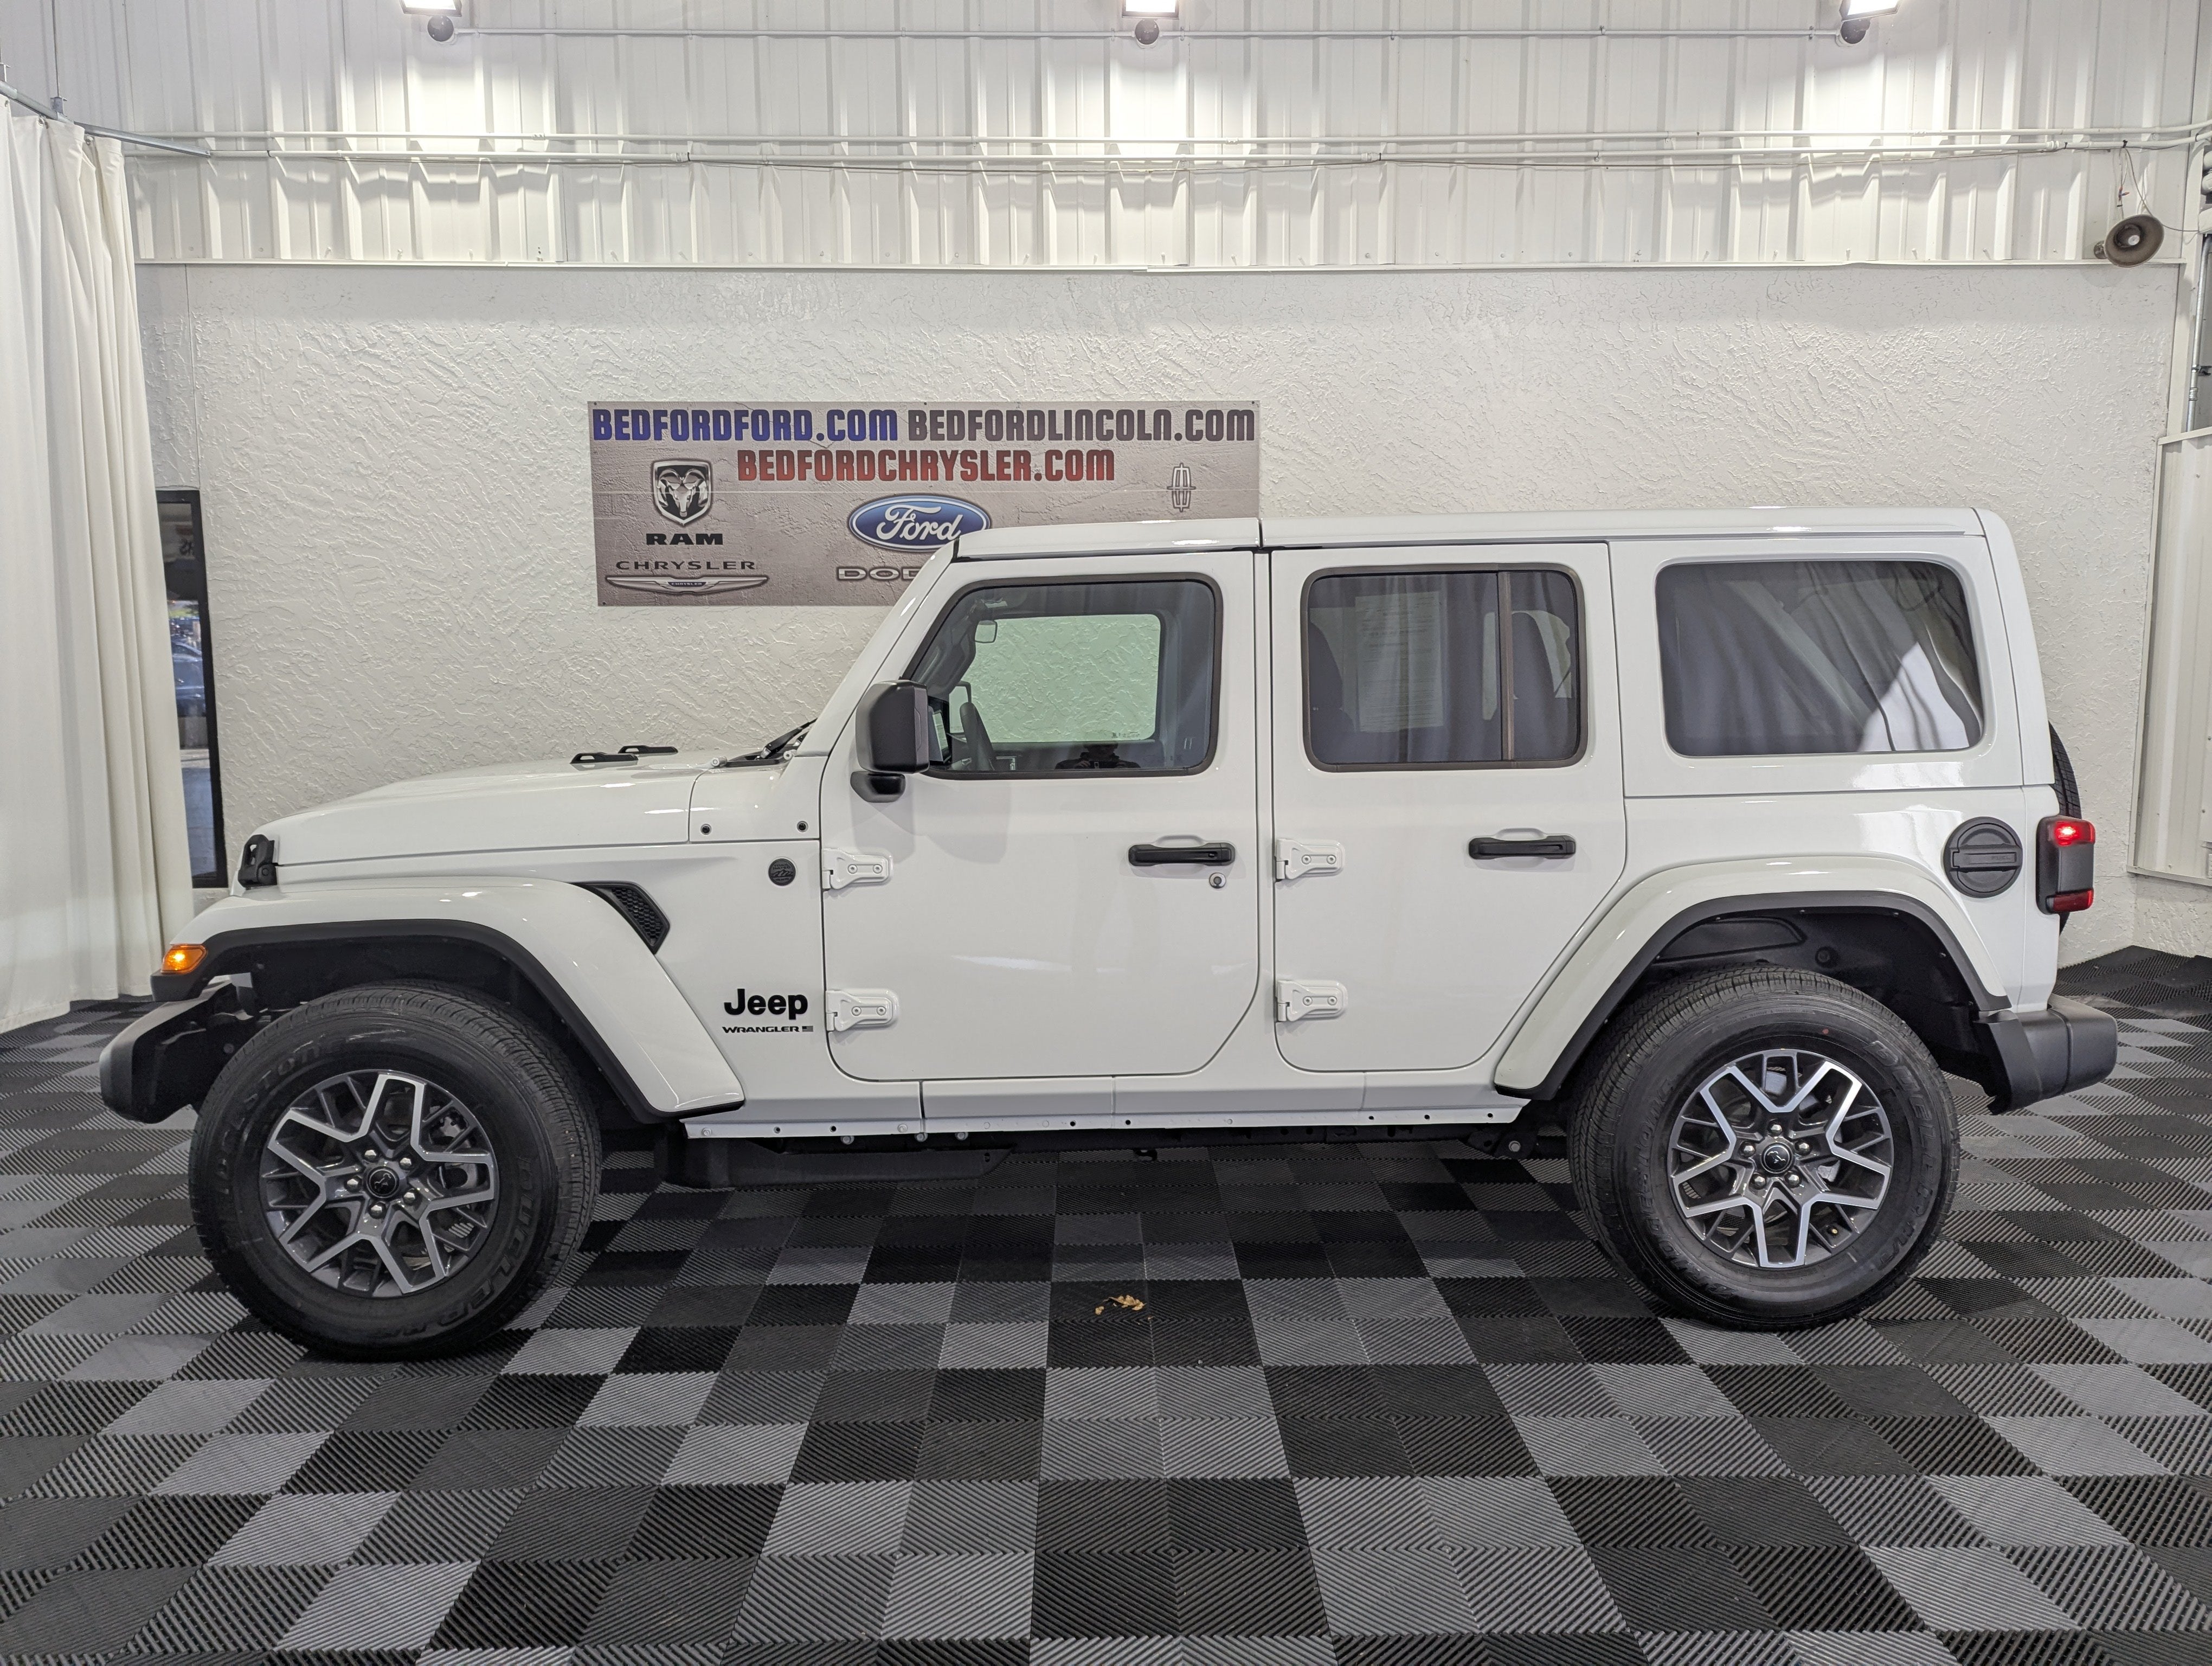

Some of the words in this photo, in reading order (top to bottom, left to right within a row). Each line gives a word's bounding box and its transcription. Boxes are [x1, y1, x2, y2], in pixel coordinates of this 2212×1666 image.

[593, 409, 898, 441] BEDFORDFORD.COM
[908, 409, 1255, 441] BEDFORDLINCOLN.COM
[737, 449, 1115, 481] BEDFORDCHRYSLER.COM
[876, 504, 963, 540] Ford
[646, 533, 724, 545] RAM
[616, 561, 756, 570] CHRYSLER
[724, 988, 808, 1020] Jeep
